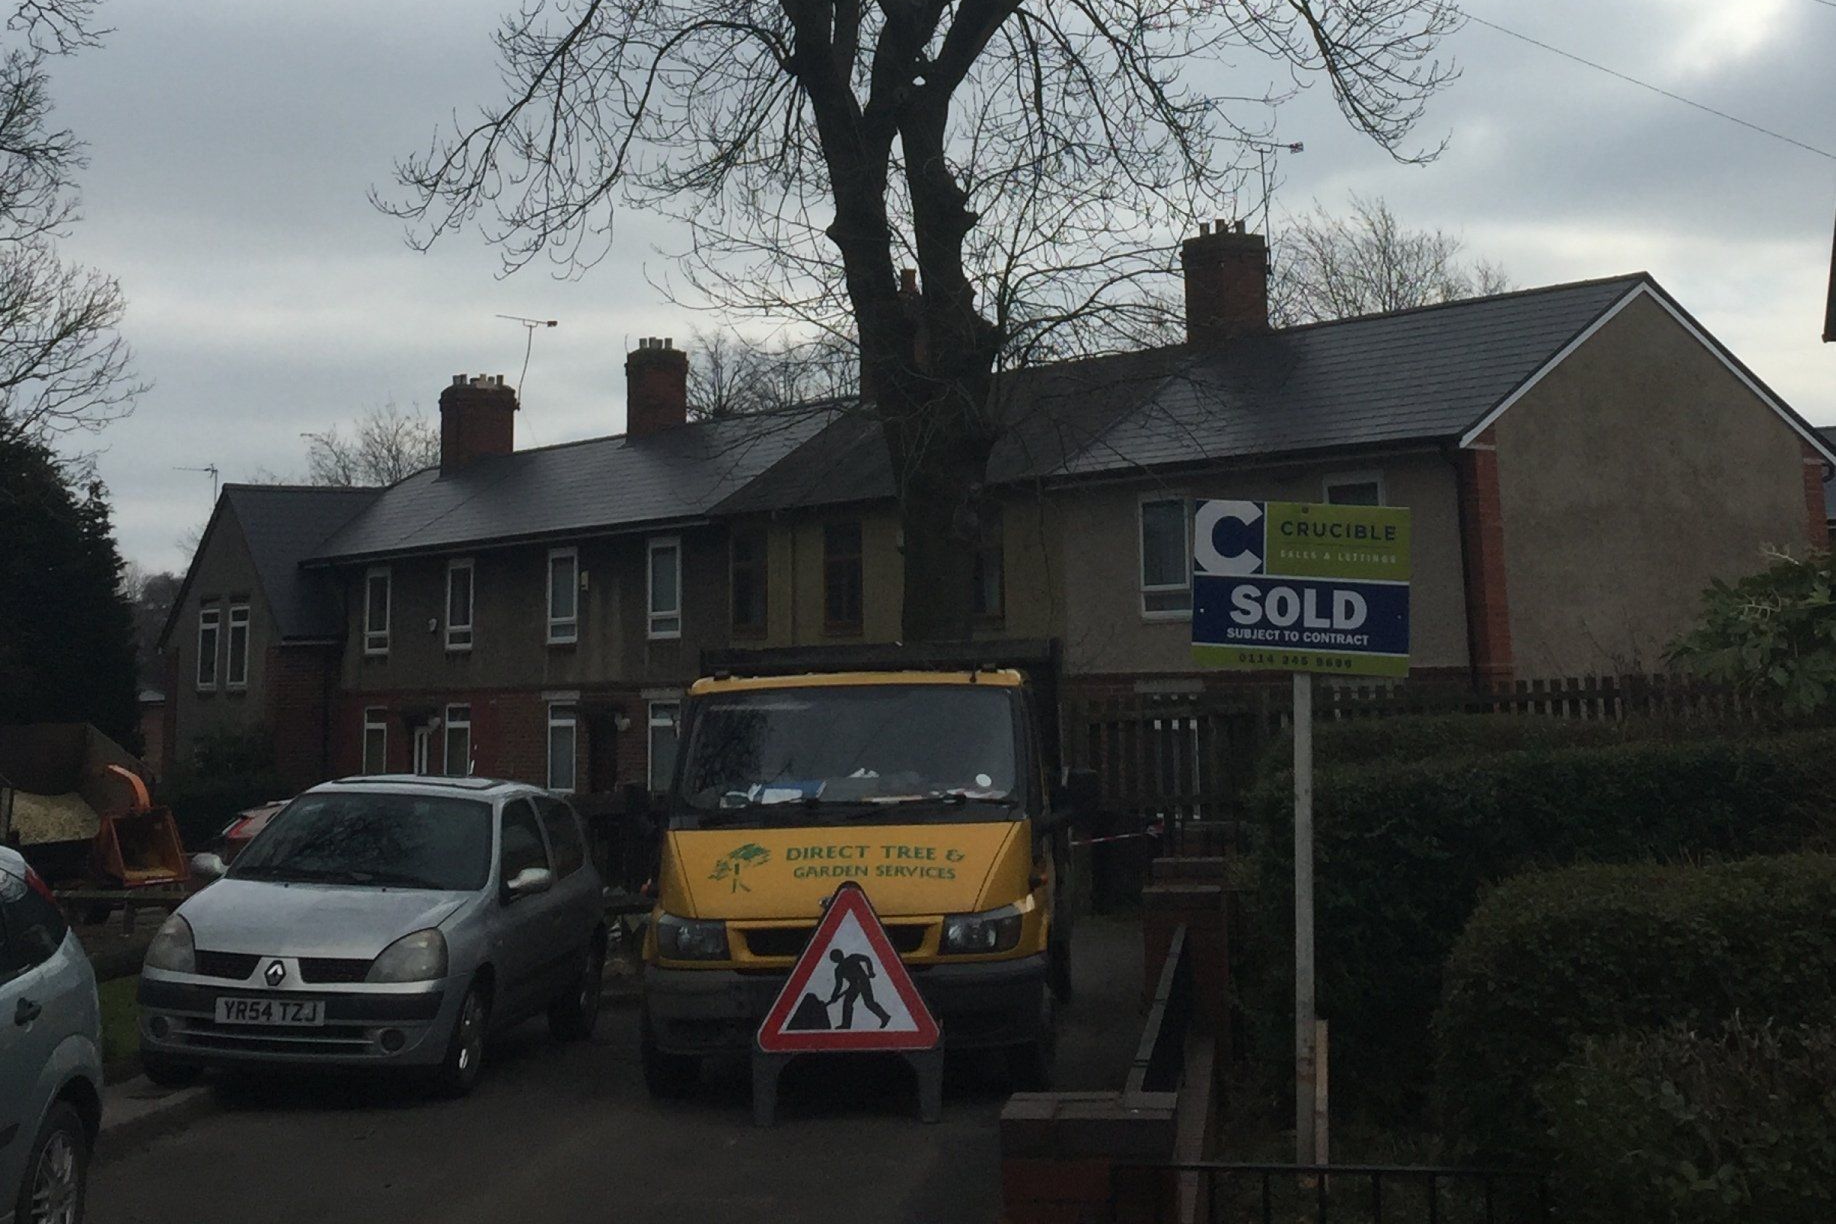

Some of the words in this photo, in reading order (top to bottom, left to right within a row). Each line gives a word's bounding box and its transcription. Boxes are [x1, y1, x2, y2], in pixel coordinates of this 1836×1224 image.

[1195, 500, 1263, 575] C
[1280, 520, 1397, 541] CRUCIBLE
[1229, 584, 1367, 630] SOLD
[1227, 627, 1280, 641] SUBJECT
[1283, 631, 1300, 642] TO
[1303, 632, 1369, 646] CONTRACT
[1239, 653, 1274, 664] 0114
[786, 845, 871, 861] DIRECT
[880, 845, 937, 861] TREE
[945, 848, 966, 863] &
[793, 865, 869, 879] GARDEN
[875, 864, 957, 880] SERVICES
[224, 1000, 273, 1021] YR54
[280, 1002, 317, 1023] TZJ
